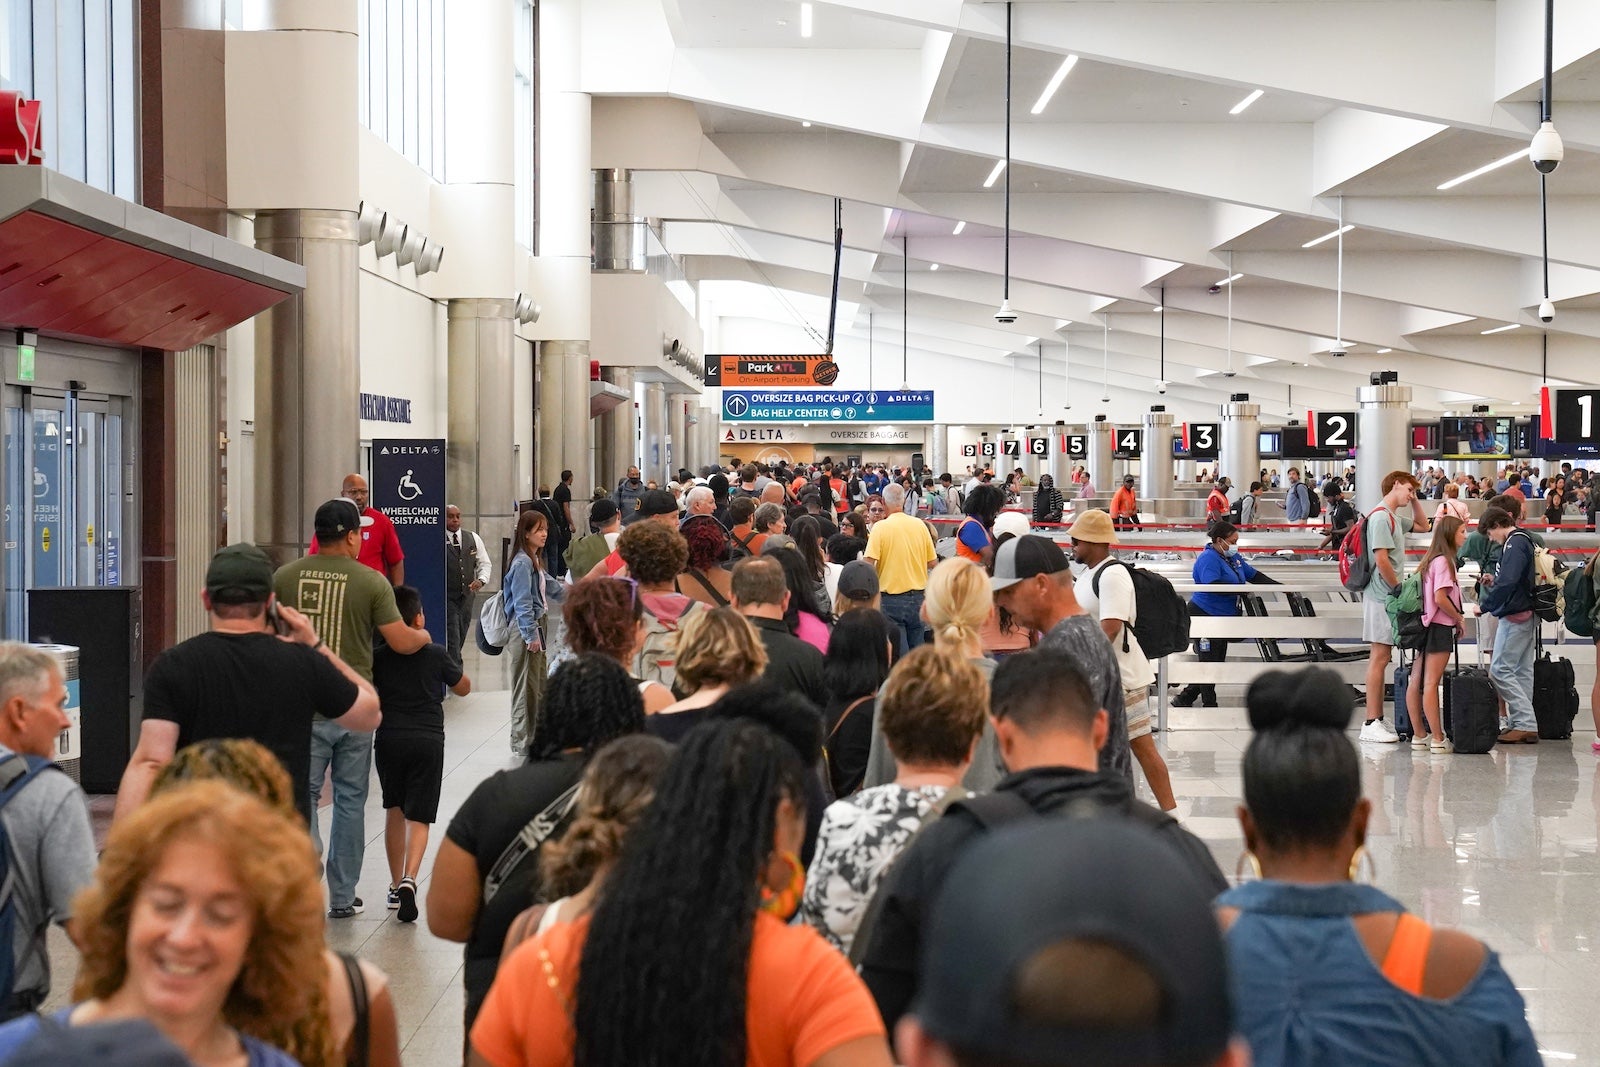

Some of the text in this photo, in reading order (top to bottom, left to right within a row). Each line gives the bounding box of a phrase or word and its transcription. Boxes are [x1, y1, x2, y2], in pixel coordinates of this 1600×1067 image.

[739, 376, 810, 384] On-Airport Parking
[751, 394, 850, 402] OVERSIZE BAG PICK-UP
[751, 408, 828, 417] BAG HELP CENTER
[1577, 395, 1592, 438] 1
[740, 429, 783, 440] DELTA
[830, 431, 909, 439] OVERSIZE BAGGAGE
[1325, 416, 1348, 446] 2
[1121, 432, 1137, 450] 4
[1196, 426, 1213, 448] 3
[984, 443, 993, 455] 8
[1006, 442, 1016, 454] 7
[1033, 440, 1044, 453] 6
[1071, 437, 1082, 452] 5
[965, 445, 974, 456] 9
[381, 507, 440, 515] WHEELCHAIR
[390, 516, 438, 524] SSISTANCE
[299, 570, 348, 580] FREEDOM
